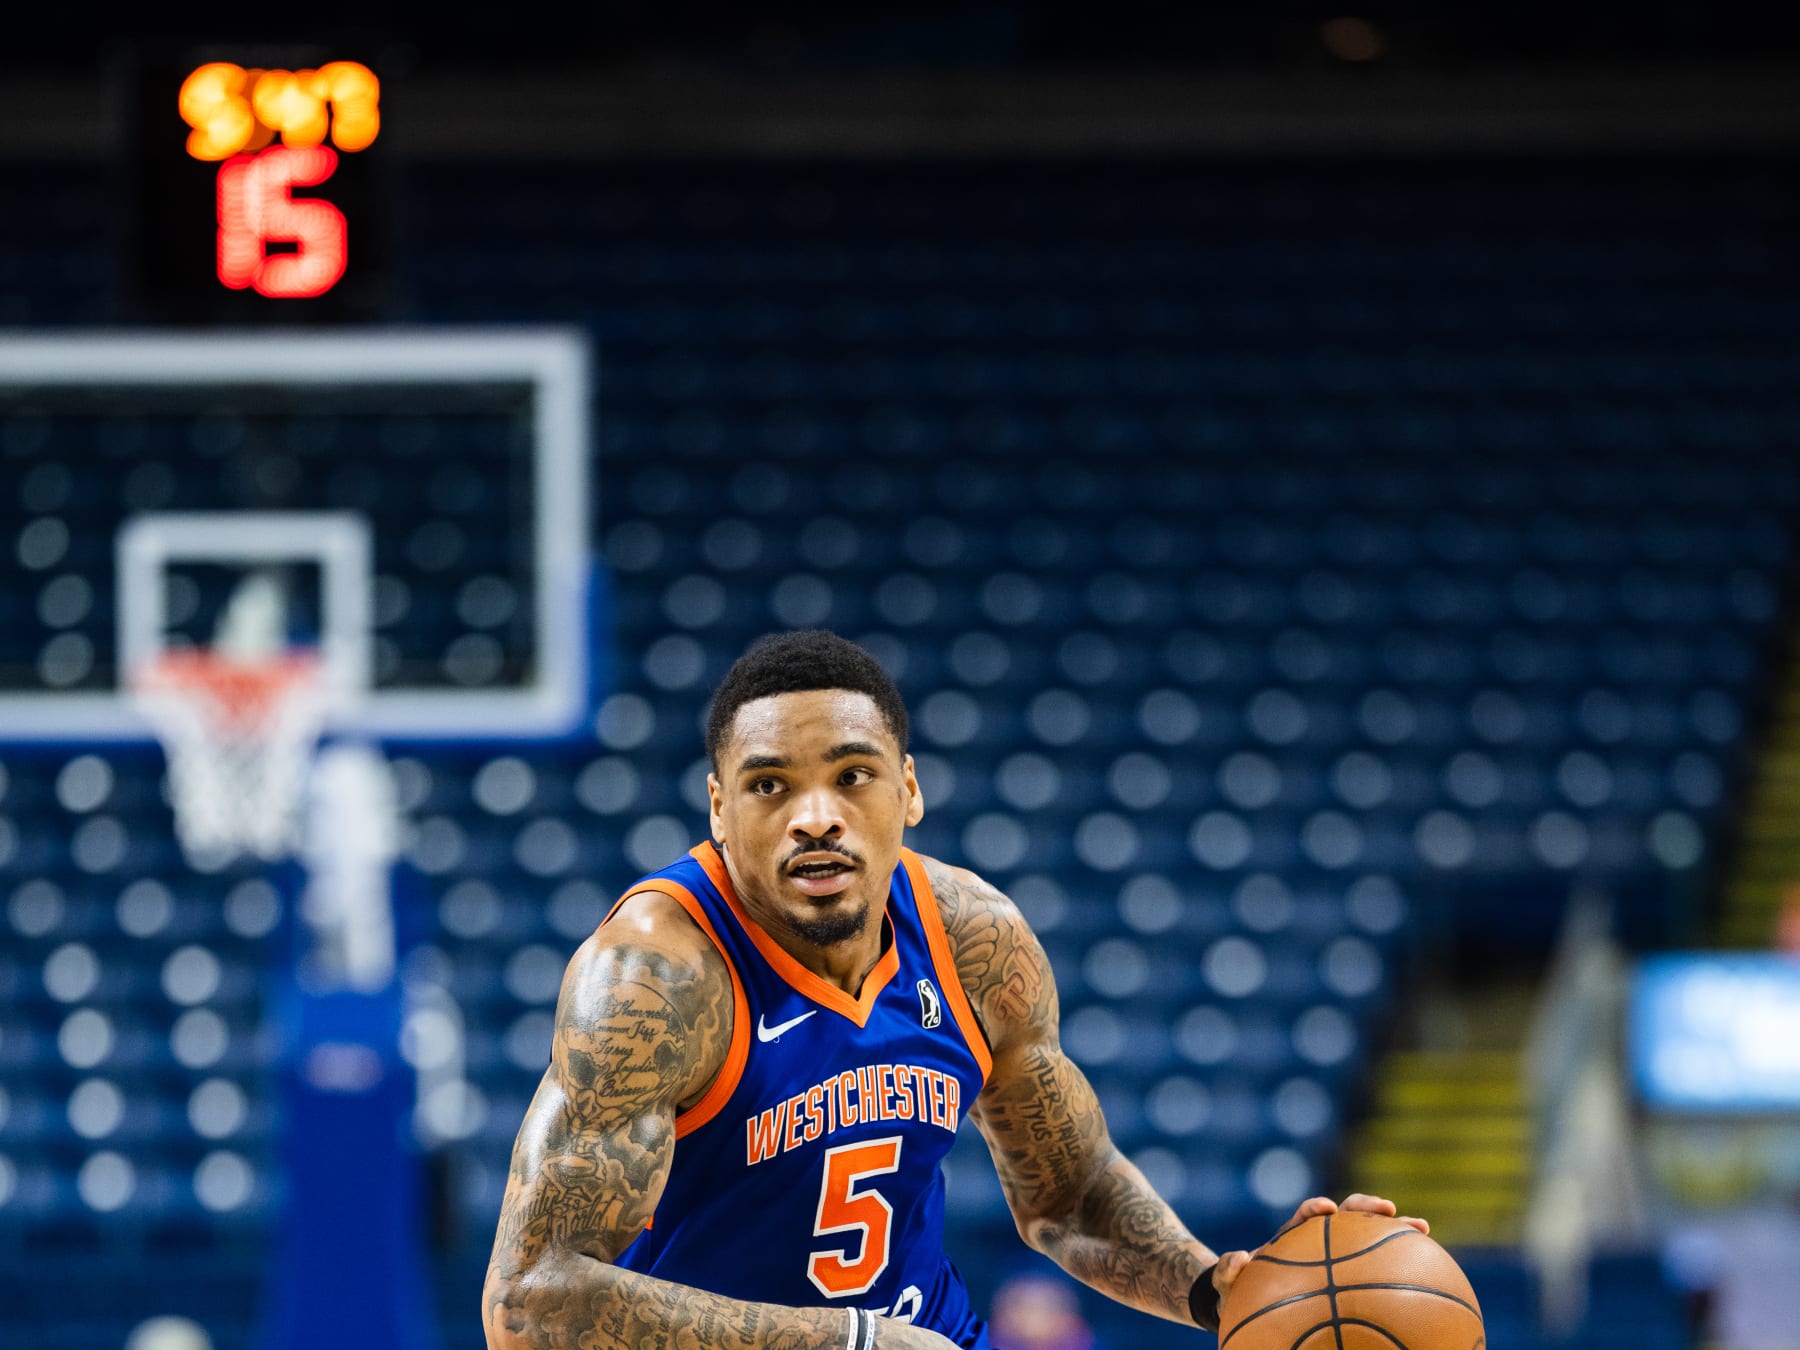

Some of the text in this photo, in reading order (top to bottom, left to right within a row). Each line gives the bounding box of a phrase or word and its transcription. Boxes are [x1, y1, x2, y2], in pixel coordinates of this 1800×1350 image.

[216, 145, 348, 298] 15
[746, 1064, 960, 1166] WESTCHESTER
[1020, 1098, 1051, 1142] TYUS
[807, 1136, 903, 1299] 5
